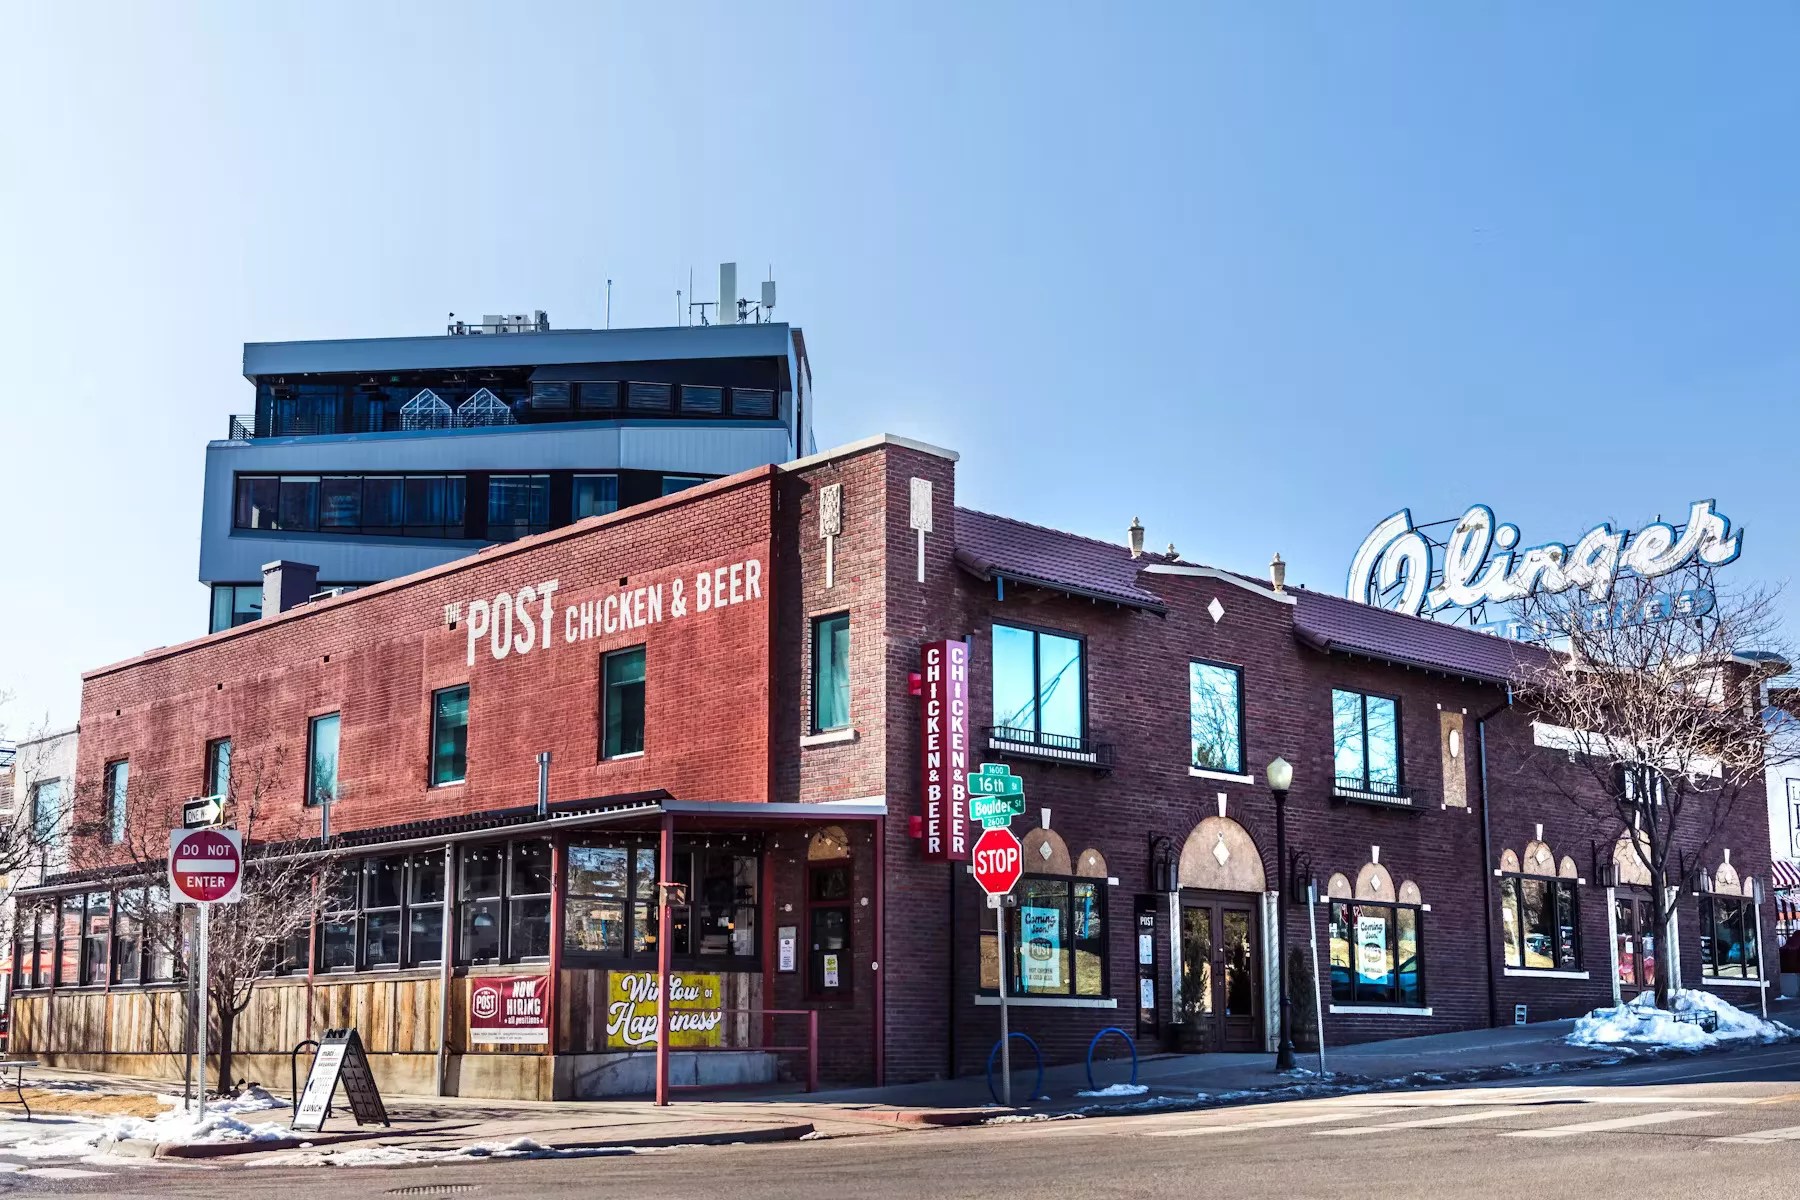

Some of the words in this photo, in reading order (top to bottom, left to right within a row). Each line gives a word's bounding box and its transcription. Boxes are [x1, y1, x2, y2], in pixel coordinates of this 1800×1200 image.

[1345, 498, 1745, 616] Olinger
[444, 601, 463, 624] THE
[466, 579, 559, 667] POST
[565, 583, 663, 644] CHICKEN
[671, 578, 688, 618] &
[696, 558, 762, 613] BEER
[988, 766, 1004, 775] 1600
[978, 776, 1005, 793] 16th
[974, 799, 1012, 816] Boulder
[1014, 799, 1022, 808] St
[187, 809, 199, 822] ONE
[987, 817, 1005, 827] 2600
[182, 844, 199, 856] DO
[207, 844, 231, 857] NOT
[977, 847, 1018, 875] STOP
[186, 875, 226, 888] ENTER
[1025, 912, 1057, 928] Coming
[1140, 916, 1154, 926] POST
[1360, 922, 1383, 933] Coming
[1031, 942, 1051, 957] POST
[512, 981, 537, 998] NOW
[704, 988, 714, 998] OF
[476, 995, 496, 1010] POST
[506, 998, 541, 1016] HIRING
[515, 1015, 540, 1026] positions
[606, 1000, 723, 1046] Hapiness
[302, 1104, 323, 1113] LUNCH
